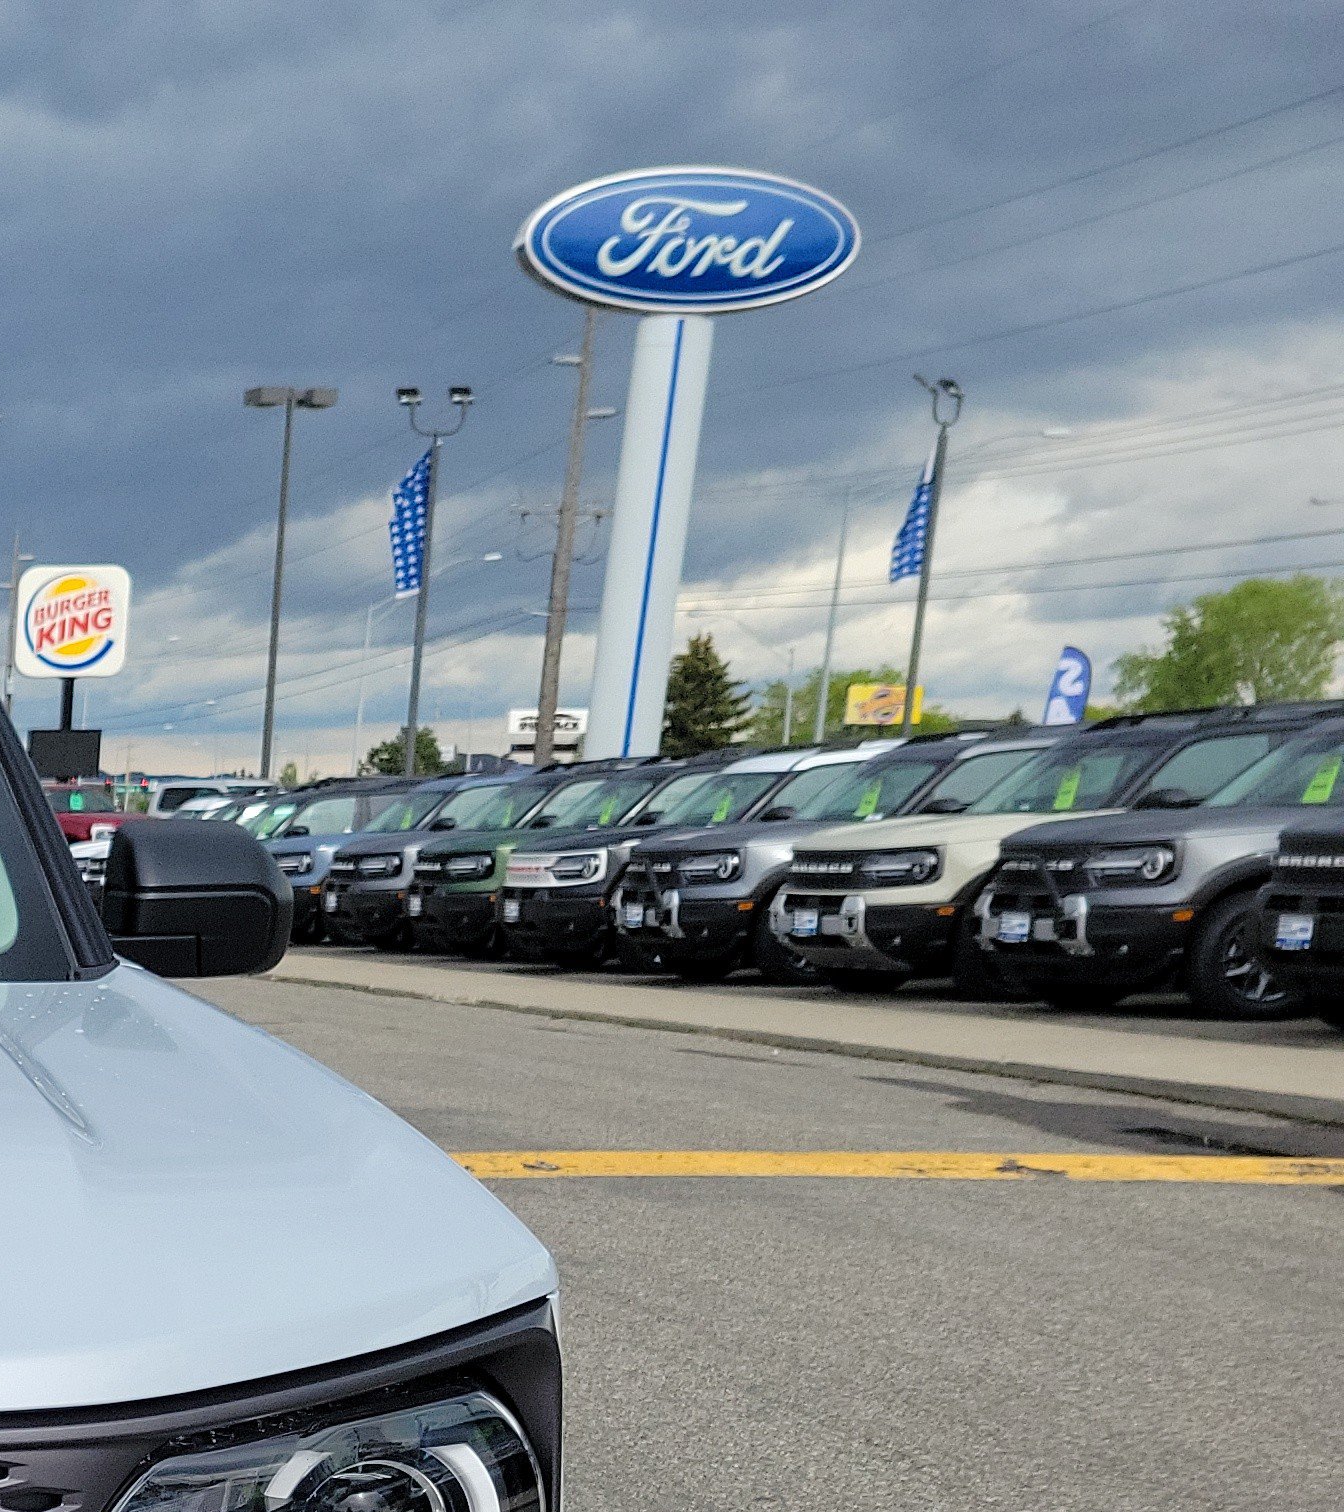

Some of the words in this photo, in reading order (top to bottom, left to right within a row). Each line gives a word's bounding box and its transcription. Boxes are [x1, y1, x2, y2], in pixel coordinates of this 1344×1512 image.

[597, 196, 795, 278] Ford
[33, 589, 111, 624] BURGER
[35, 606, 113, 652] KING
